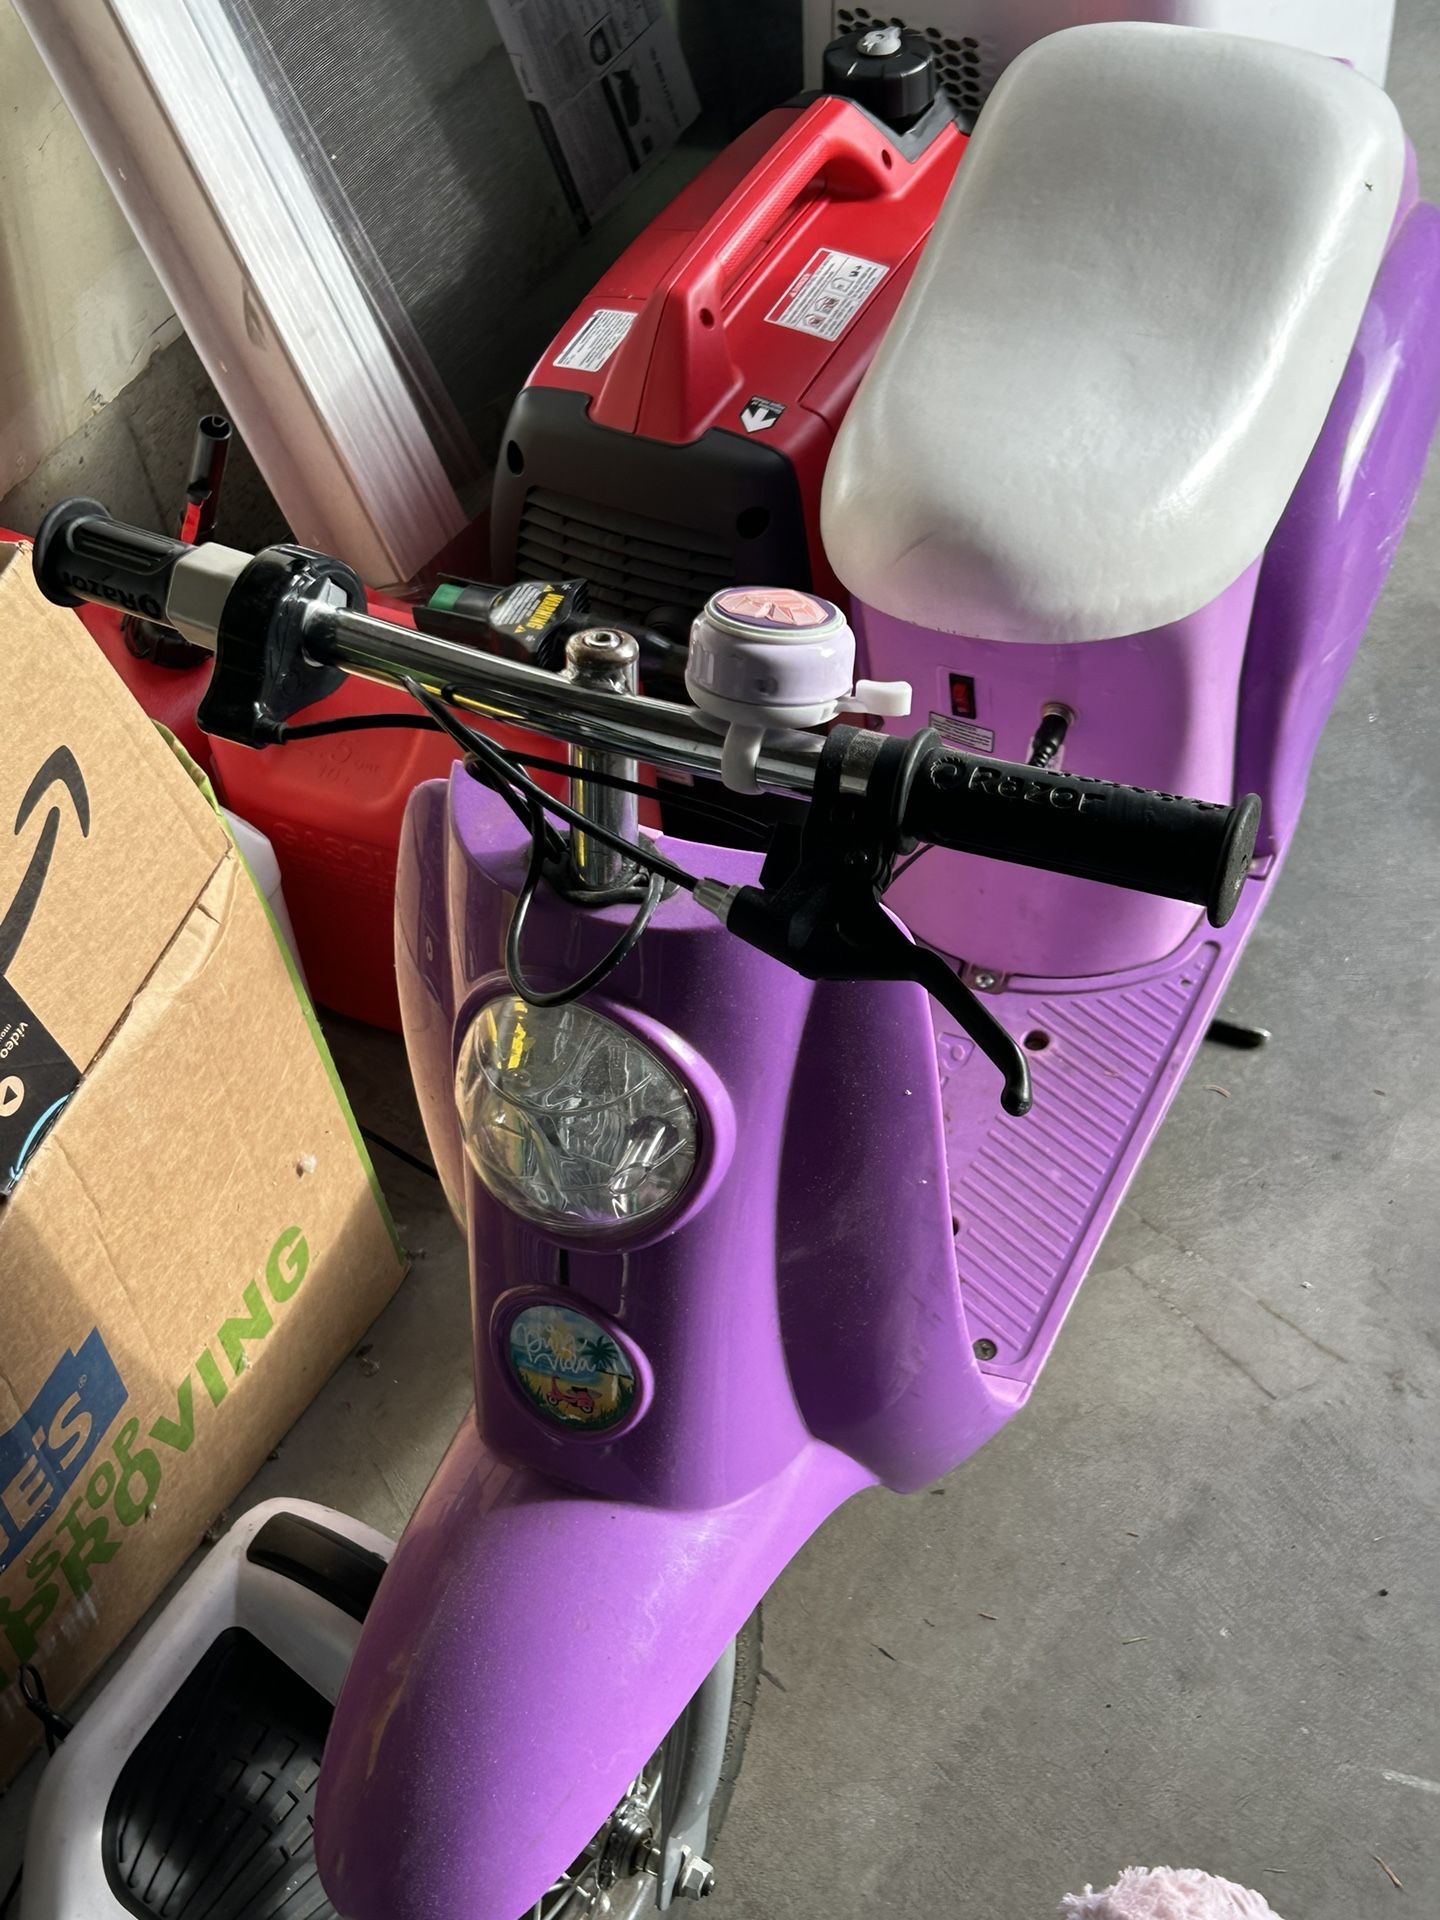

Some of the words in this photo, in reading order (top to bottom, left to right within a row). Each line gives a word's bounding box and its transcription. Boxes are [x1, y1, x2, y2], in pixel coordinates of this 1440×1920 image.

[526, 593, 564, 630] WARNING
[968, 766, 1107, 813] Razor
[0, 1022, 29, 1059] video
[0, 1226, 309, 1692] PROVING
[0, 1391, 92, 1550] E'S
[26, 1417, 139, 1592] STOP
